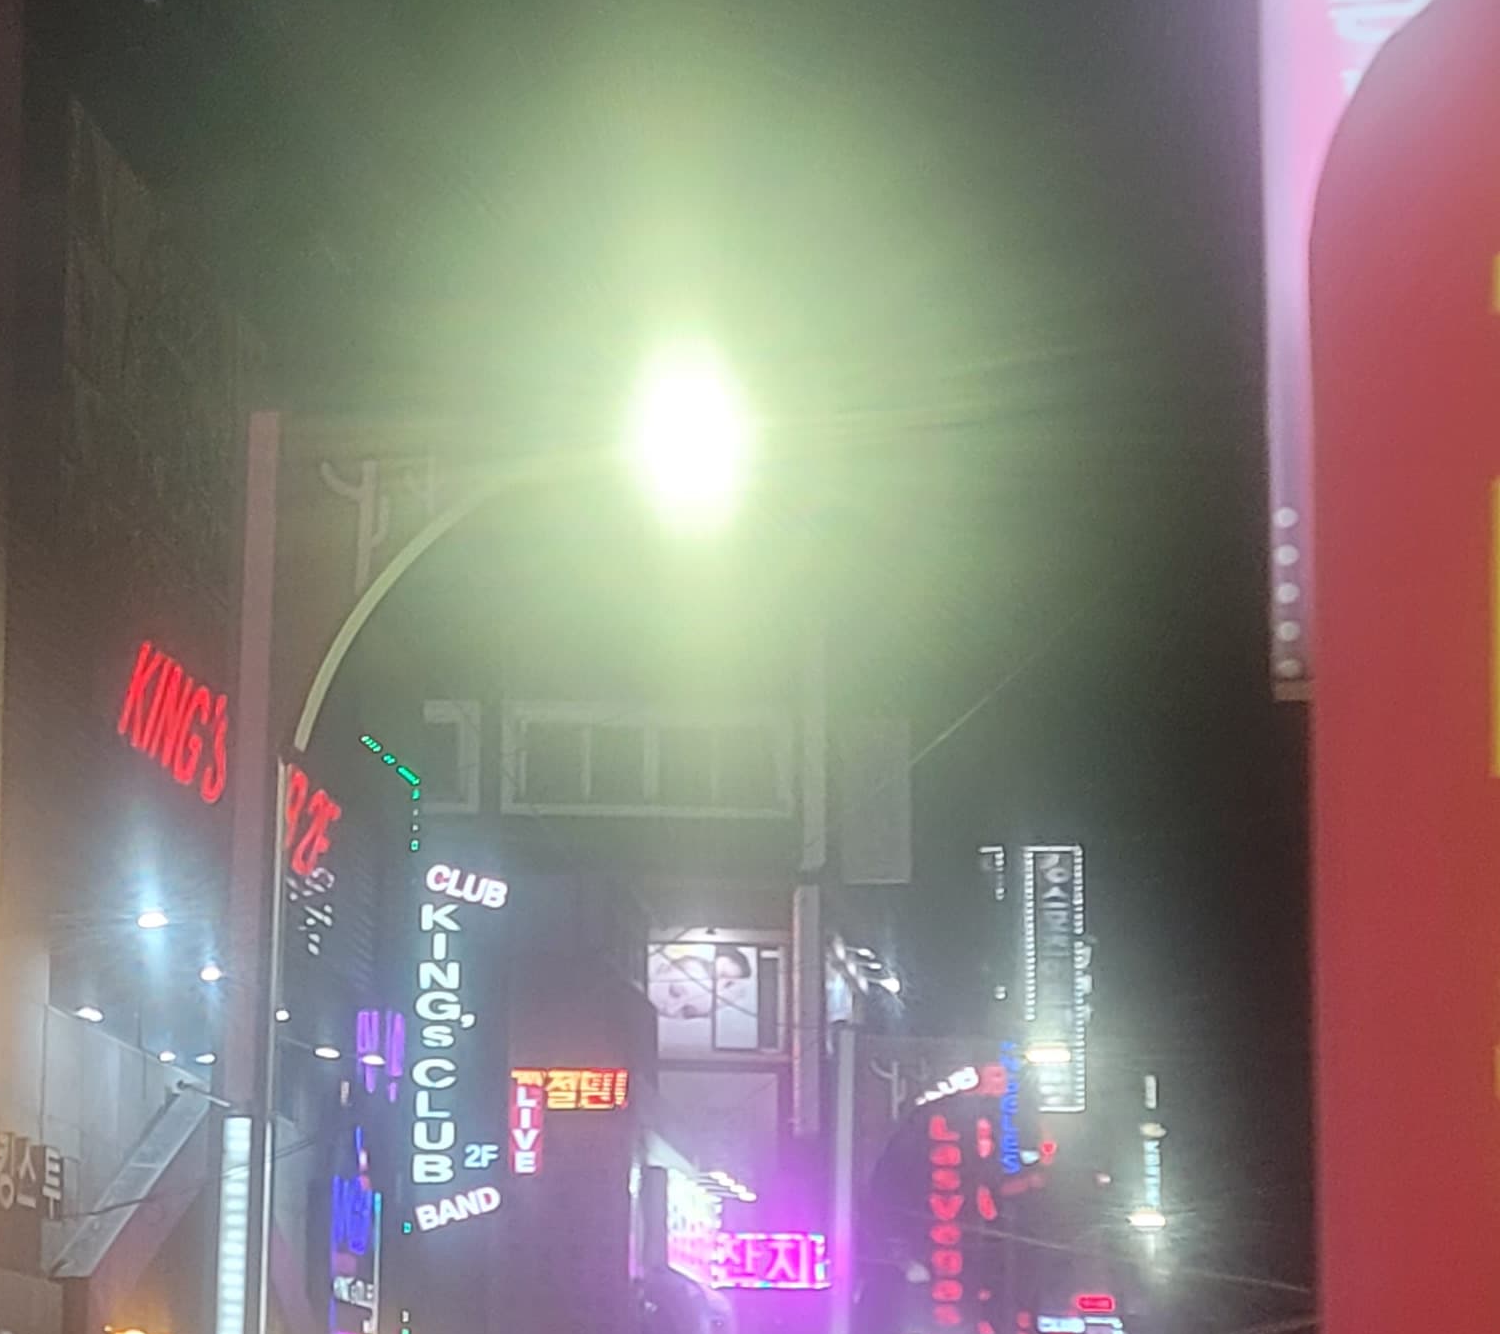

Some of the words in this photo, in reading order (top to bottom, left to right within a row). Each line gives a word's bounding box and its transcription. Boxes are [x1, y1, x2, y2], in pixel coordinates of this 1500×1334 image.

[425, 864, 508, 909] CLUB
[512, 1085, 540, 1174] LIVE
[463, 1143, 499, 1170] 2F
[415, 1185, 502, 1233] BAND
